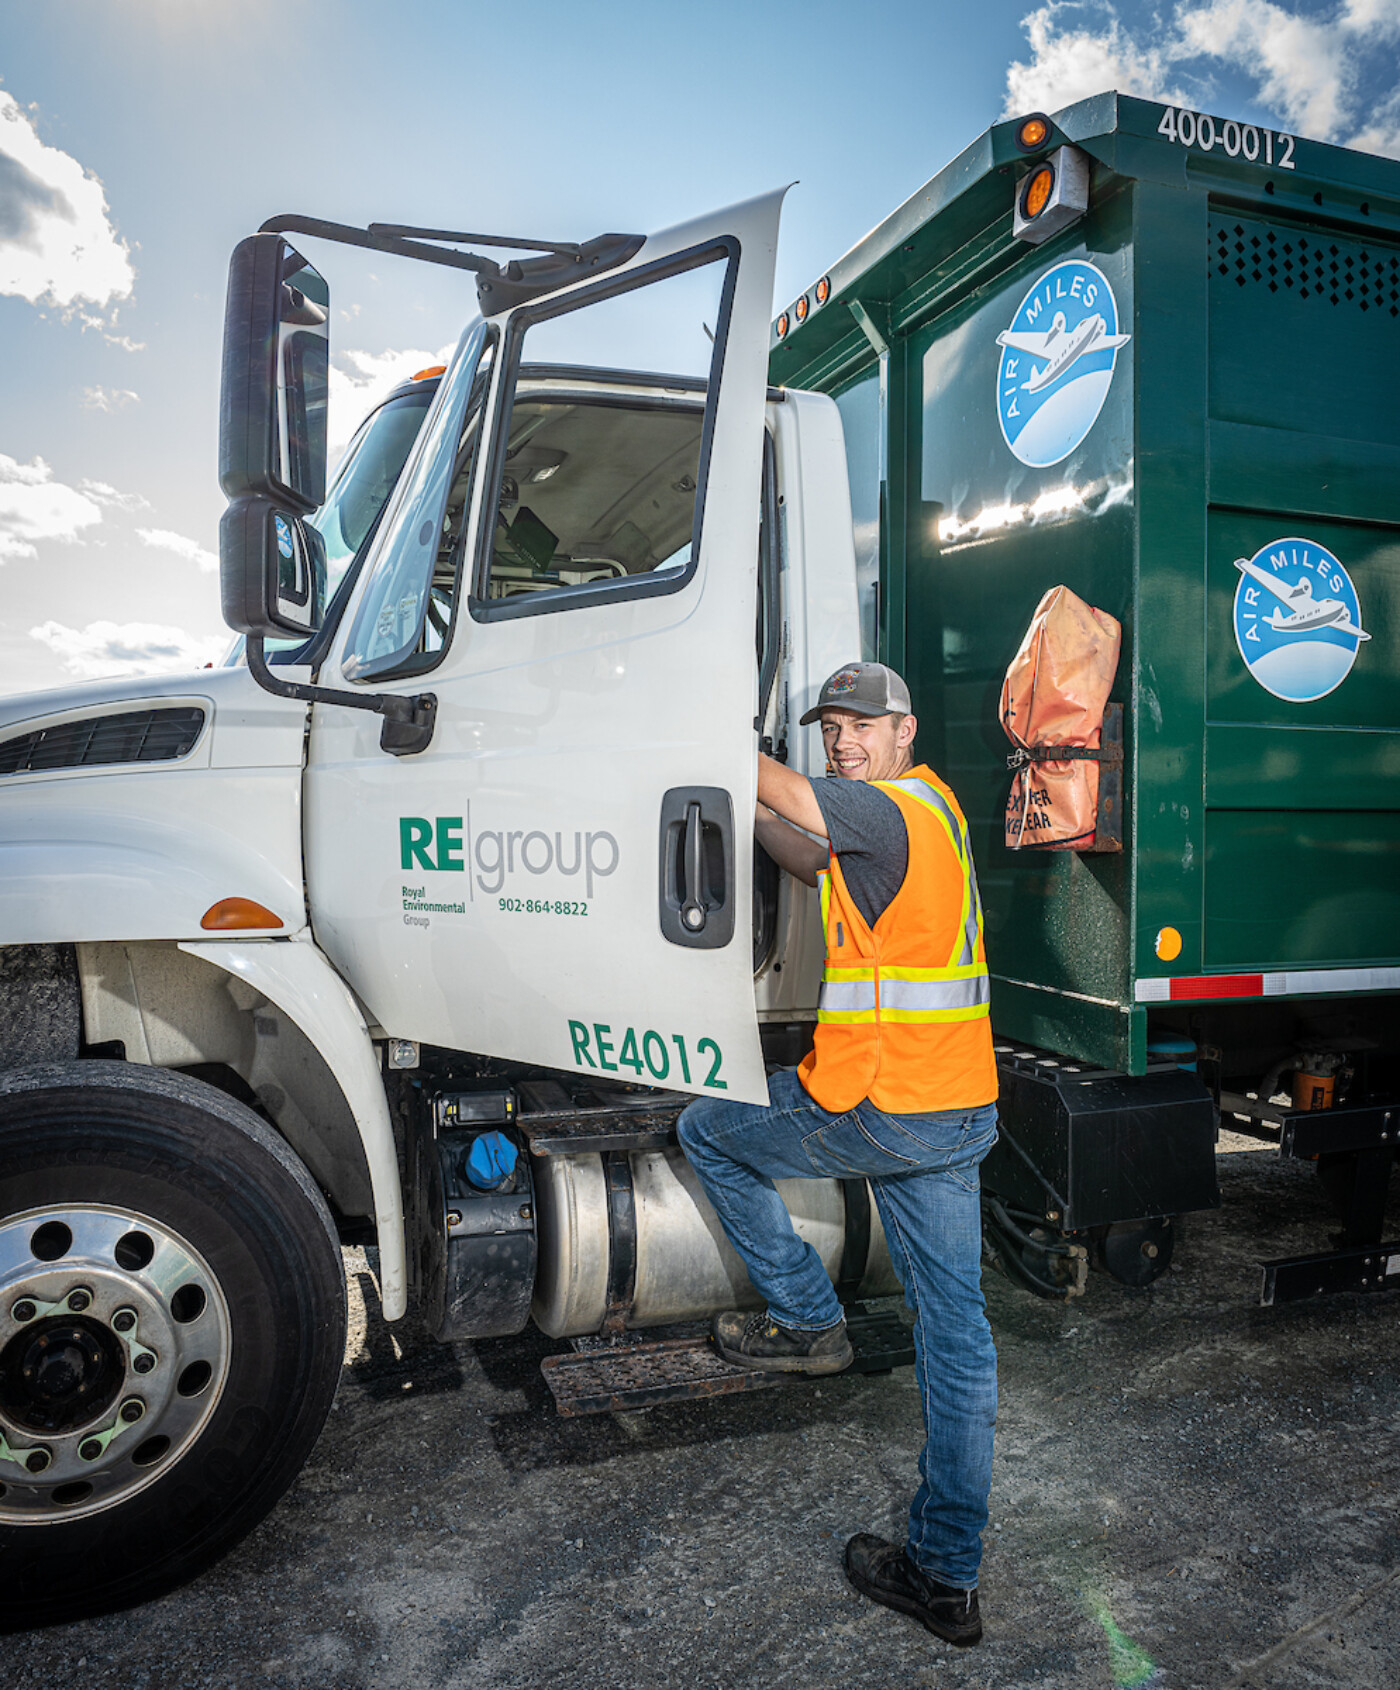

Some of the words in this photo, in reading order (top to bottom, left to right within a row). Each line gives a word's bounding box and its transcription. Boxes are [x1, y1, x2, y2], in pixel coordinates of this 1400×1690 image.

[1157, 106, 1295, 170] 400-0012
[1005, 358, 1020, 418] AIR
[1026, 275, 1098, 325] MILES
[1243, 587, 1261, 642] AIR
[1270, 548, 1343, 593] MILES
[399, 817, 465, 872] RE
[475, 830, 620, 899] group
[402, 885, 426, 900] Royal
[402, 899, 466, 914] Environmental
[403, 913, 430, 930] Group
[568, 1019, 728, 1090] RE4012
